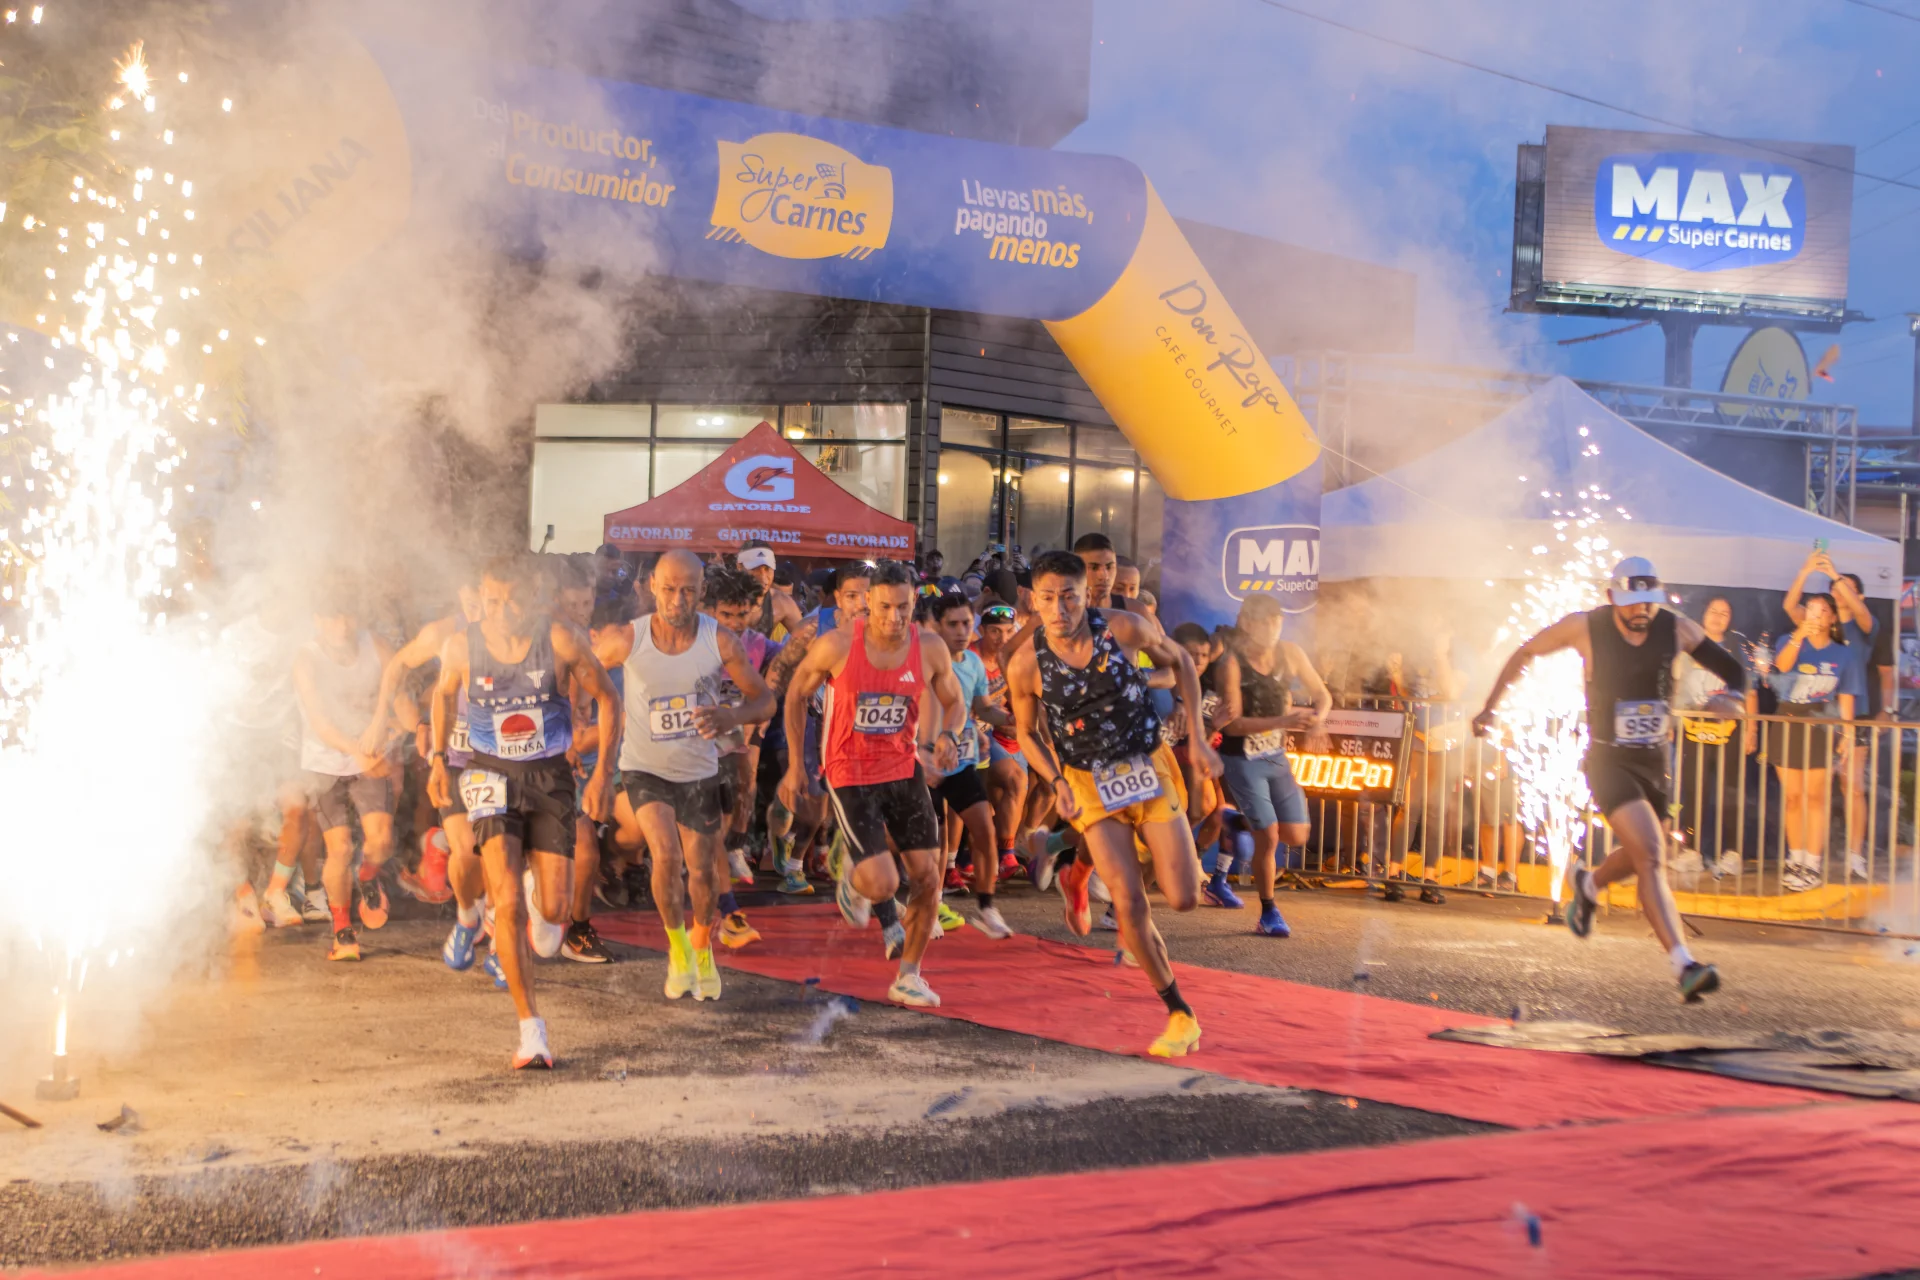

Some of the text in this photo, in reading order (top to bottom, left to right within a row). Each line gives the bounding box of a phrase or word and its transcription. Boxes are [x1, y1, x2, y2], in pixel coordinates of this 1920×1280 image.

[511, 109, 657, 169] Productor,
[505, 151, 676, 208] Consumidor
[736, 153, 818, 223] Super
[962, 179, 1094, 225] Llevas más,
[1611, 163, 1793, 229] MAX
[770, 194, 868, 236] Carnes
[955, 207, 1048, 239] pagando
[989, 235, 1081, 269] menos
[1158, 279, 1284, 415] Don Rafa
[1155, 326, 1239, 438] CAFÉ GOURMET
[708, 502, 812, 514] GATORADE
[608, 526, 693, 541] GATORADE
[718, 528, 801, 544] GATORADE
[825, 532, 909, 549] GATORADE
[661, 710, 695, 730] 812
[859, 708, 905, 725] 1043
[500, 740, 545, 756] REINSA
[1340, 739, 1366, 757] SEG.
[1373, 740, 1394, 760] C.S.
[464, 785, 496, 809] 872
[1100, 769, 1155, 802] 1086
